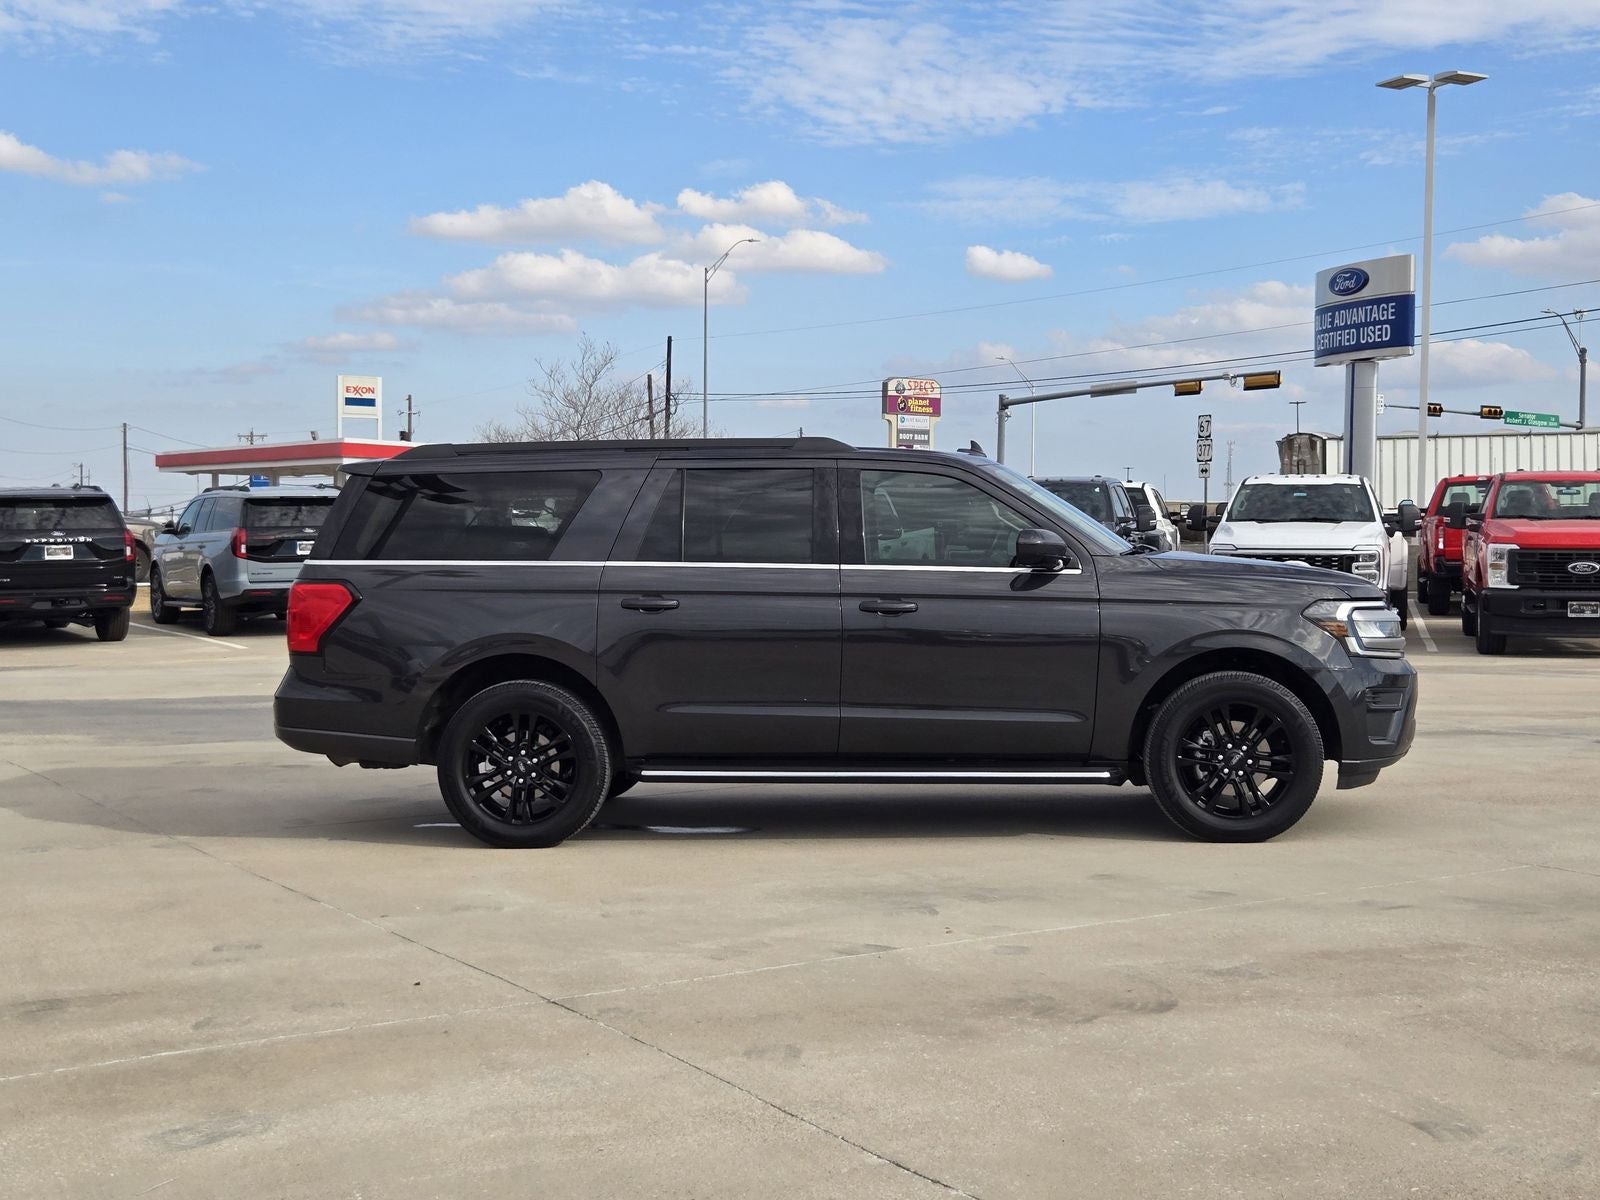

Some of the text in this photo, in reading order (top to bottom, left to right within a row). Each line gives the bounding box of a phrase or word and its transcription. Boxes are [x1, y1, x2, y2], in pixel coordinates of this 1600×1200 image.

[1334, 273, 1357, 291] Ford
[1333, 303, 1396, 327] ADVANTAGE
[1317, 324, 1391, 350] CERTIFIED USED
[345, 385, 375, 397] EXXON
[907, 380, 935, 393] SPEC'S
[1199, 420, 1210, 433] 67
[1198, 444, 1211, 457] 377
